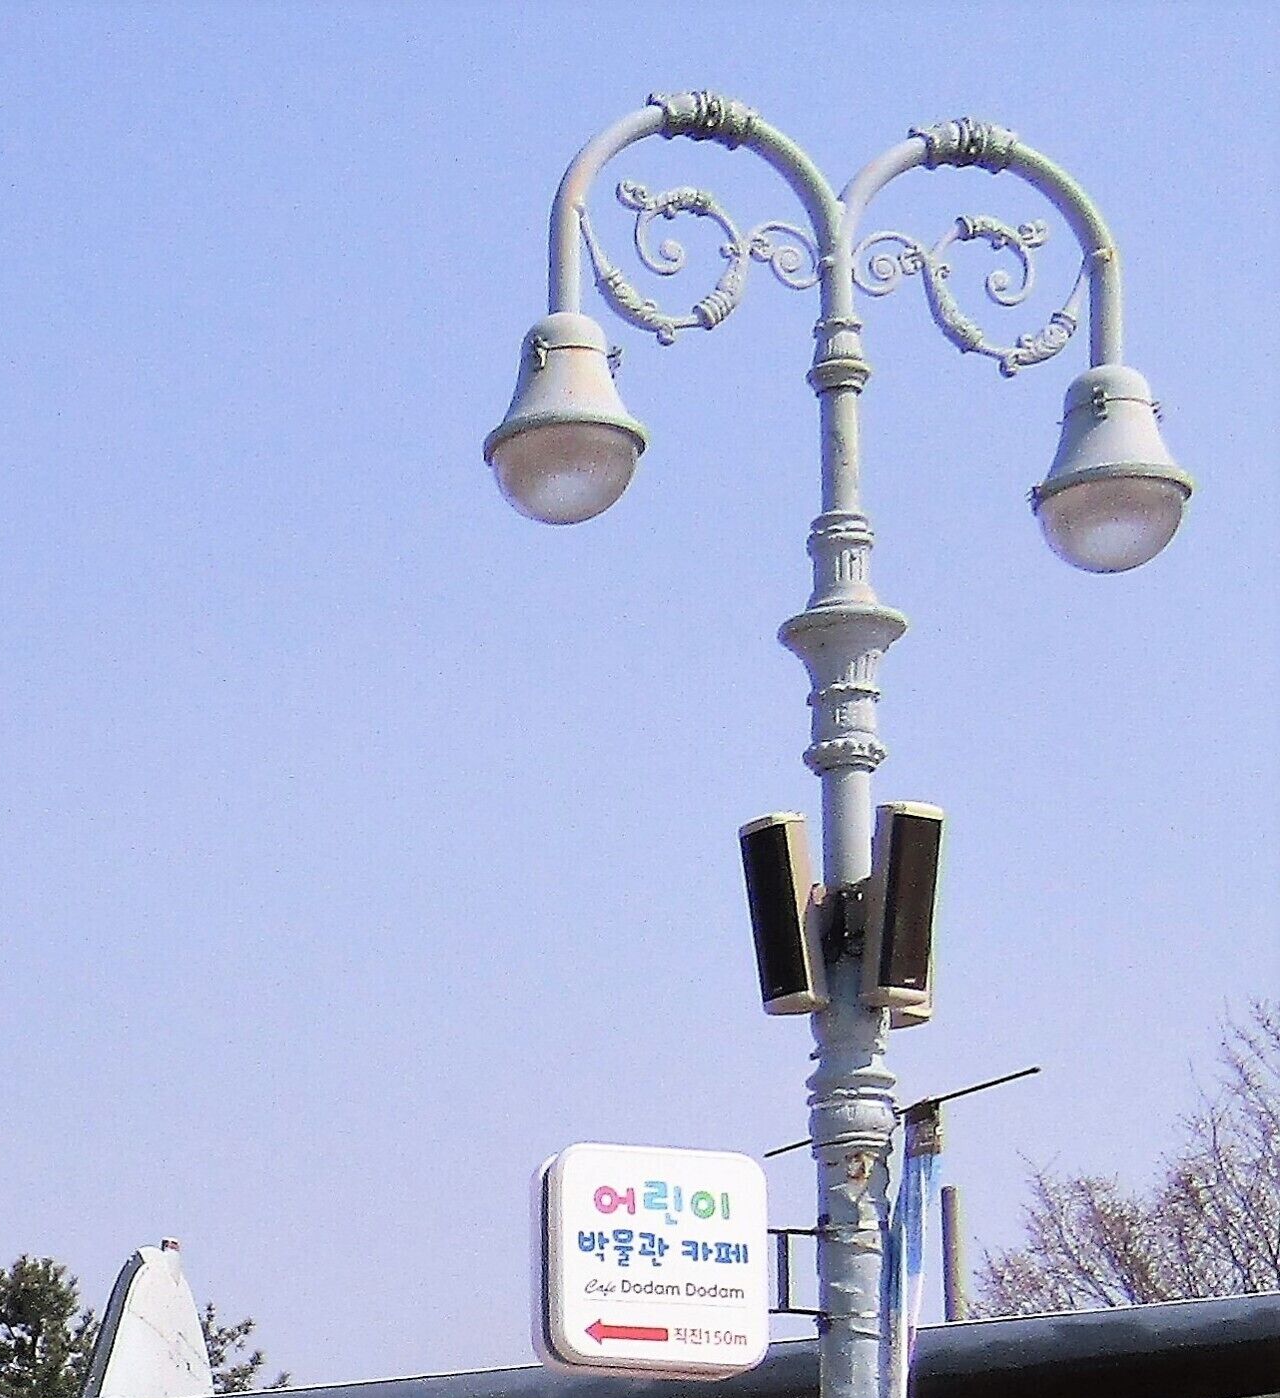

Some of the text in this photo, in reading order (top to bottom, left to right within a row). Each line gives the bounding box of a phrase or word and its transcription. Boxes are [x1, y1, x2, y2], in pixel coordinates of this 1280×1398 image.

[593, 1180, 731, 1225] 어린이
[577, 1228, 749, 1268] 박물관 카페
[620, 1279, 681, 1297] Dodam
[685, 1282, 745, 1300] Dodam
